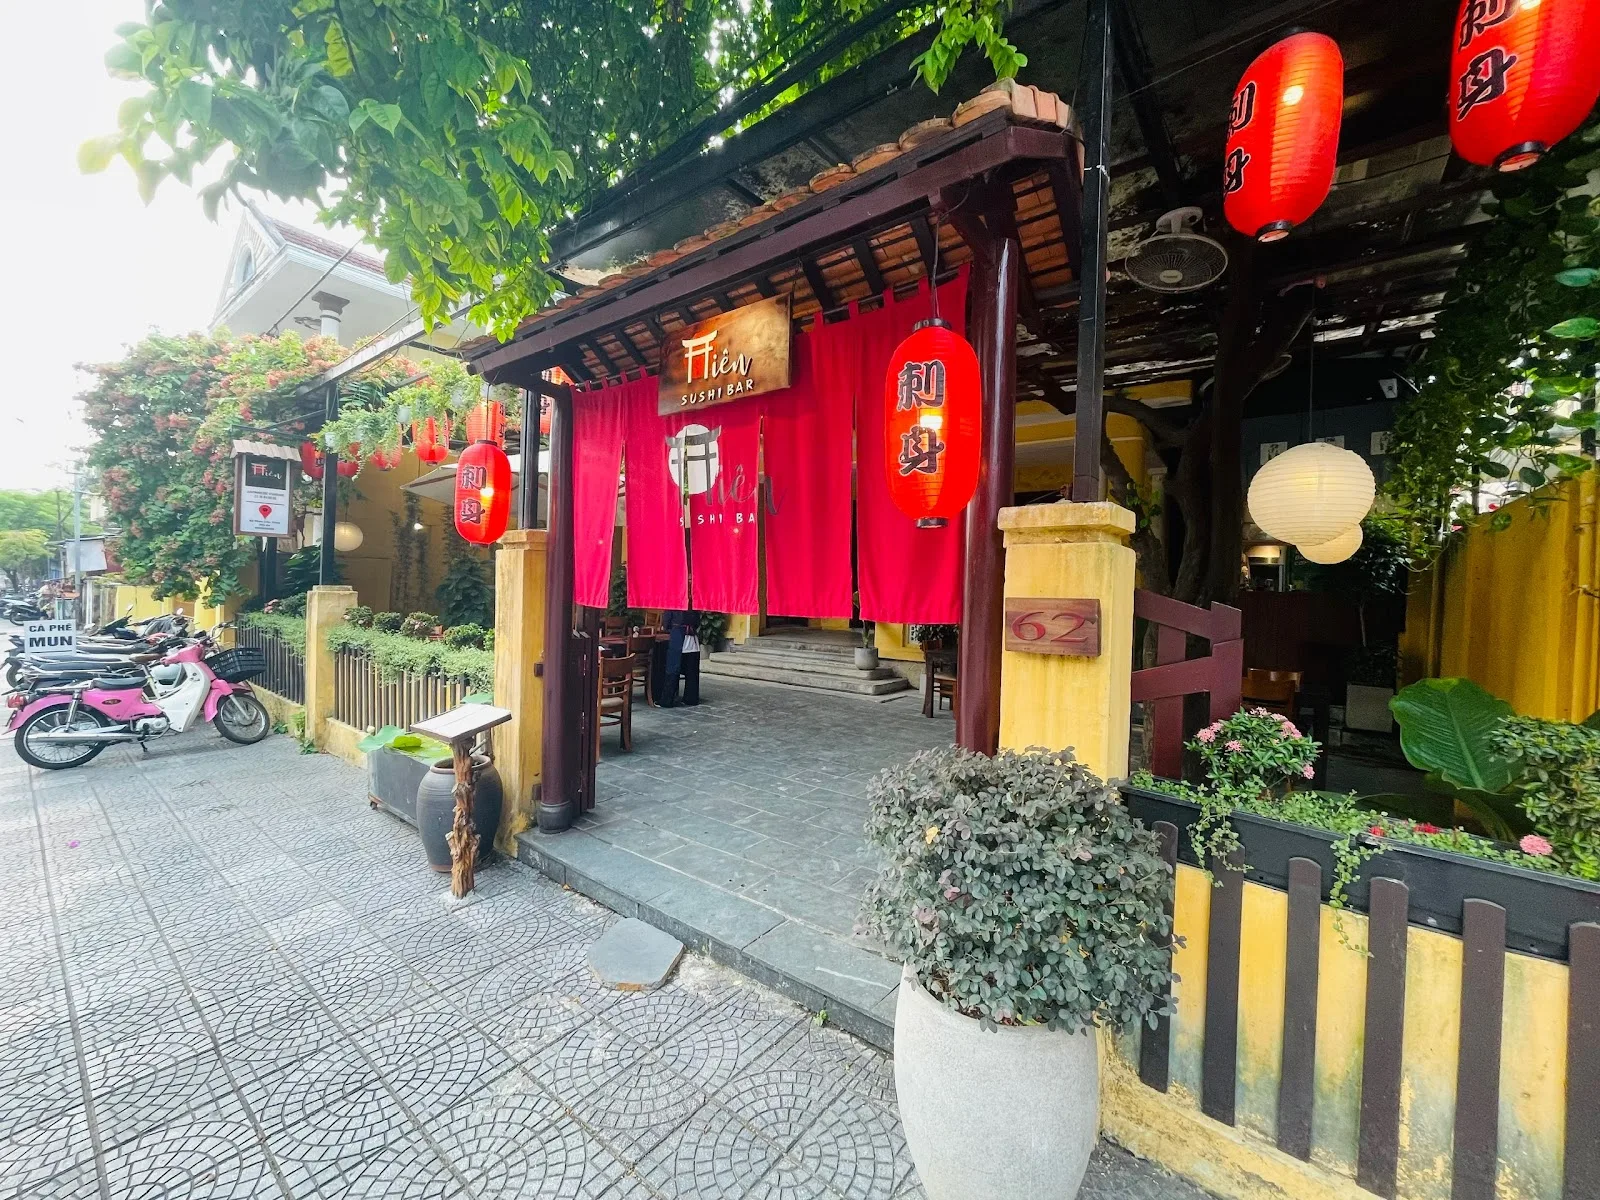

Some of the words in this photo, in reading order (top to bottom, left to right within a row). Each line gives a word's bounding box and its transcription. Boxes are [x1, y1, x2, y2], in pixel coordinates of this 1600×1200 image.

[682, 329, 753, 384] Hiên
[680, 387, 722, 406] SUSHI
[727, 378, 754, 396] BAR
[896, 358, 946, 476] 刺身
[29, 636, 72, 647] MUN
[1011, 611, 1088, 642] 62
